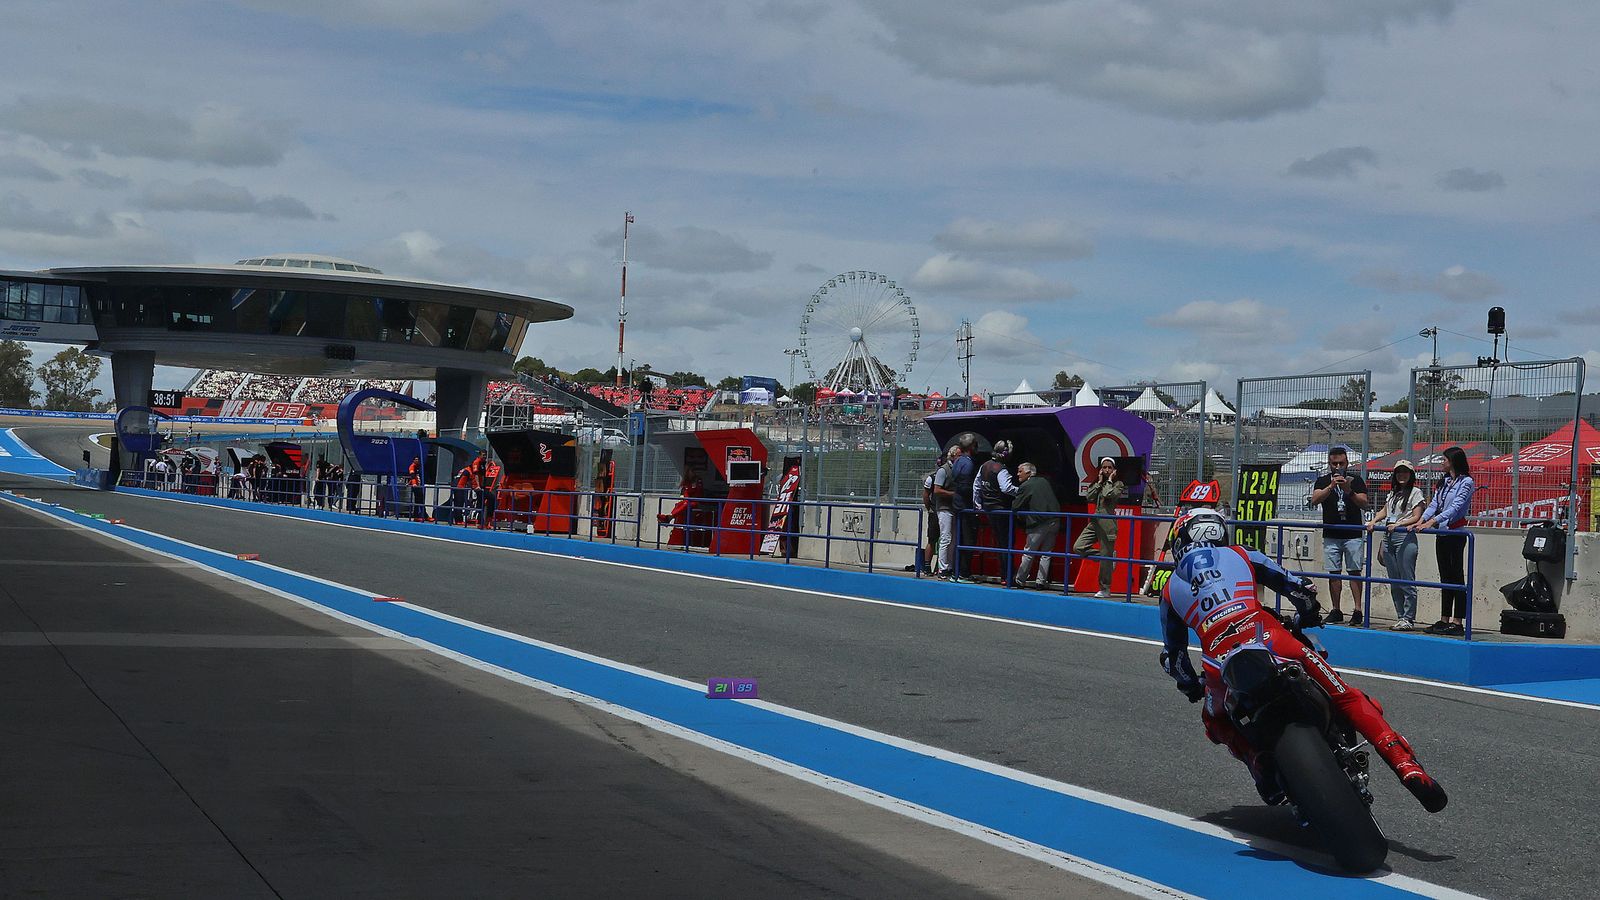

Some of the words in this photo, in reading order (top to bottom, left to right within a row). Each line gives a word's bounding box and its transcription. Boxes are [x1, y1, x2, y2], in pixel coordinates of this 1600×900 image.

[153, 393, 176, 406] 38:51
[928, 400, 944, 409] 93
[219, 400, 246, 418] WE
[1190, 485, 1210, 500] 89
[1188, 522, 1222, 542] 73
[1152, 569, 1172, 591] 36
[1200, 588, 1232, 612] OLI
[1212, 605, 1242, 621] MICHELIN
[1301, 647, 1346, 694] alpinestars
[714, 683, 728, 693] 21
[737, 683, 753, 693] 89
